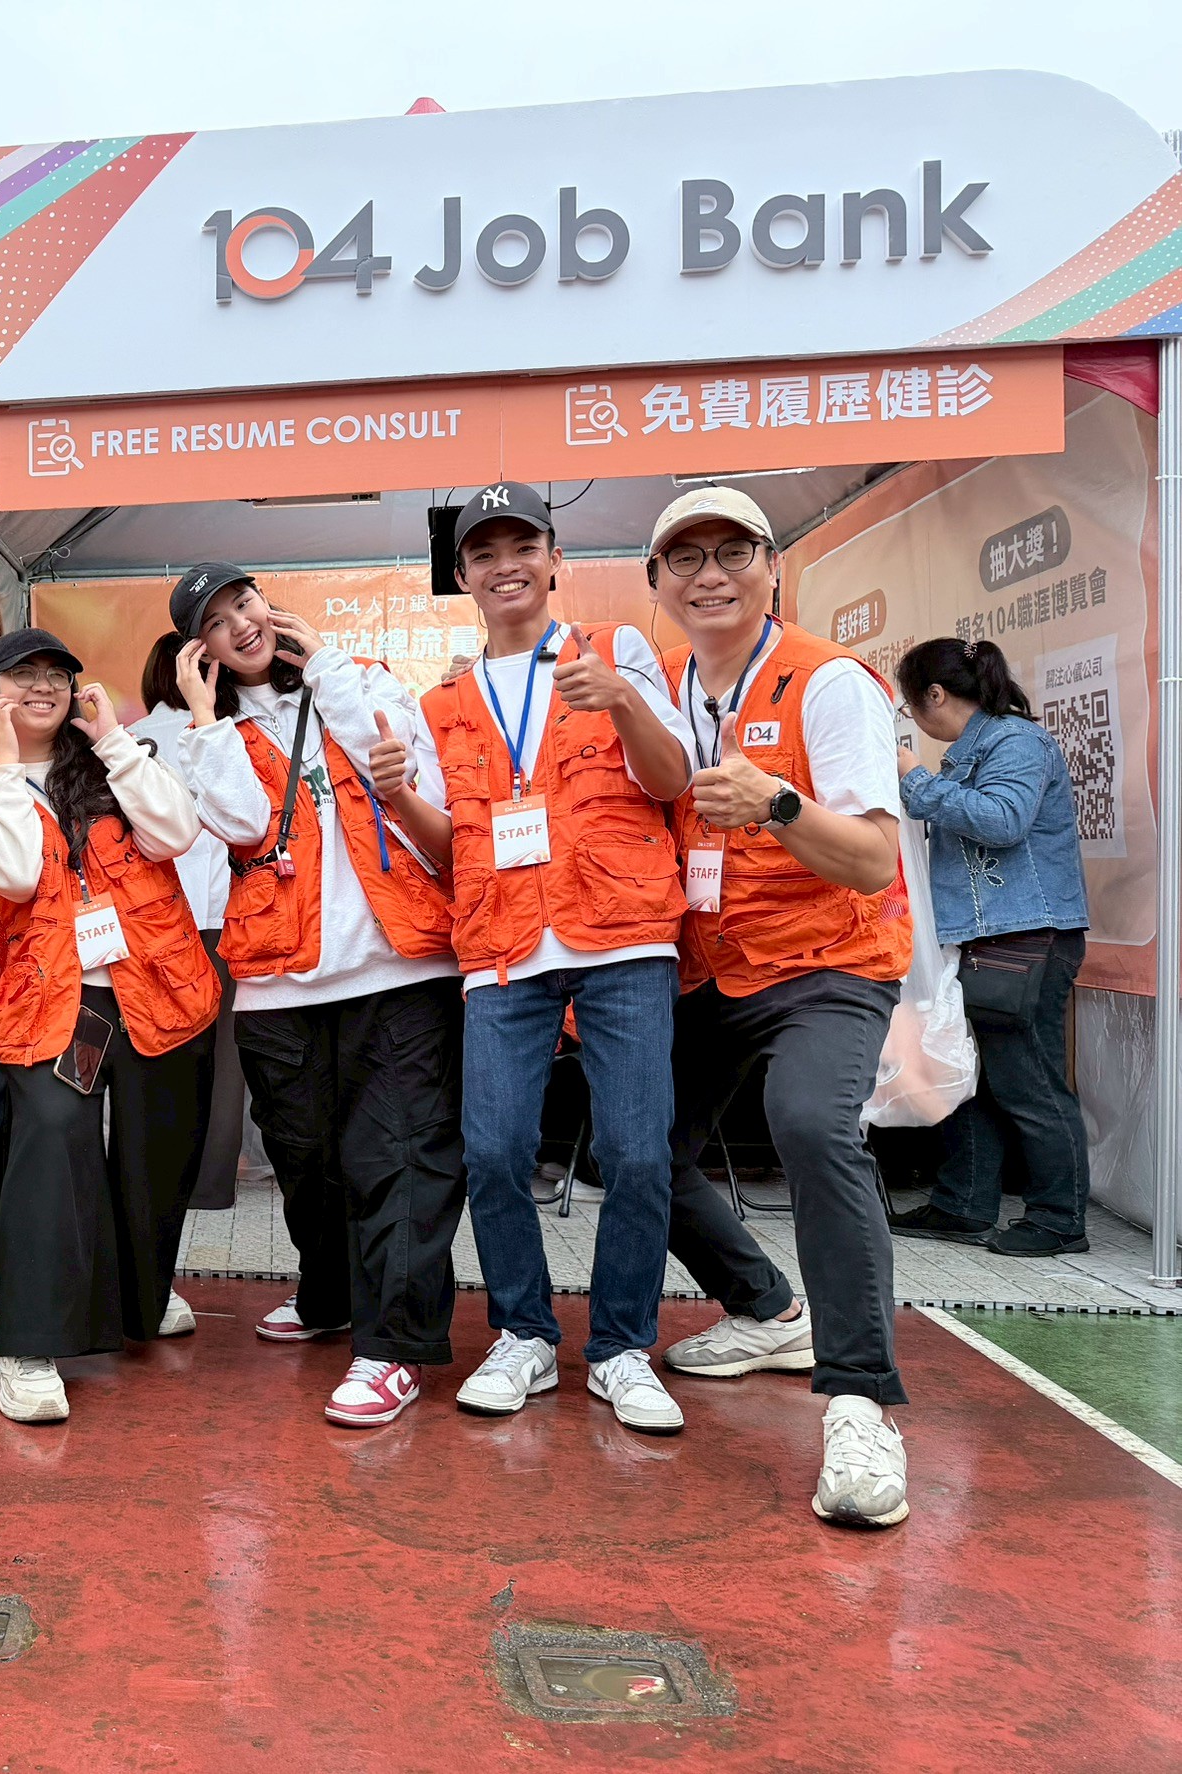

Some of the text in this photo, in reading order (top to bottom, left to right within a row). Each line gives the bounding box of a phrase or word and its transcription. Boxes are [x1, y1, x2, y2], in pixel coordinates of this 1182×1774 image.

[201, 159, 995, 305] 104 Job Bank
[640, 363, 994, 435] 免費履歷健診
[91, 409, 462, 458] FREE RESUME CONSULT
[748, 725, 774, 743] 104
[498, 824, 542, 841] STAFF
[689, 866, 718, 880] STAFF
[77, 921, 116, 942] STAFF
